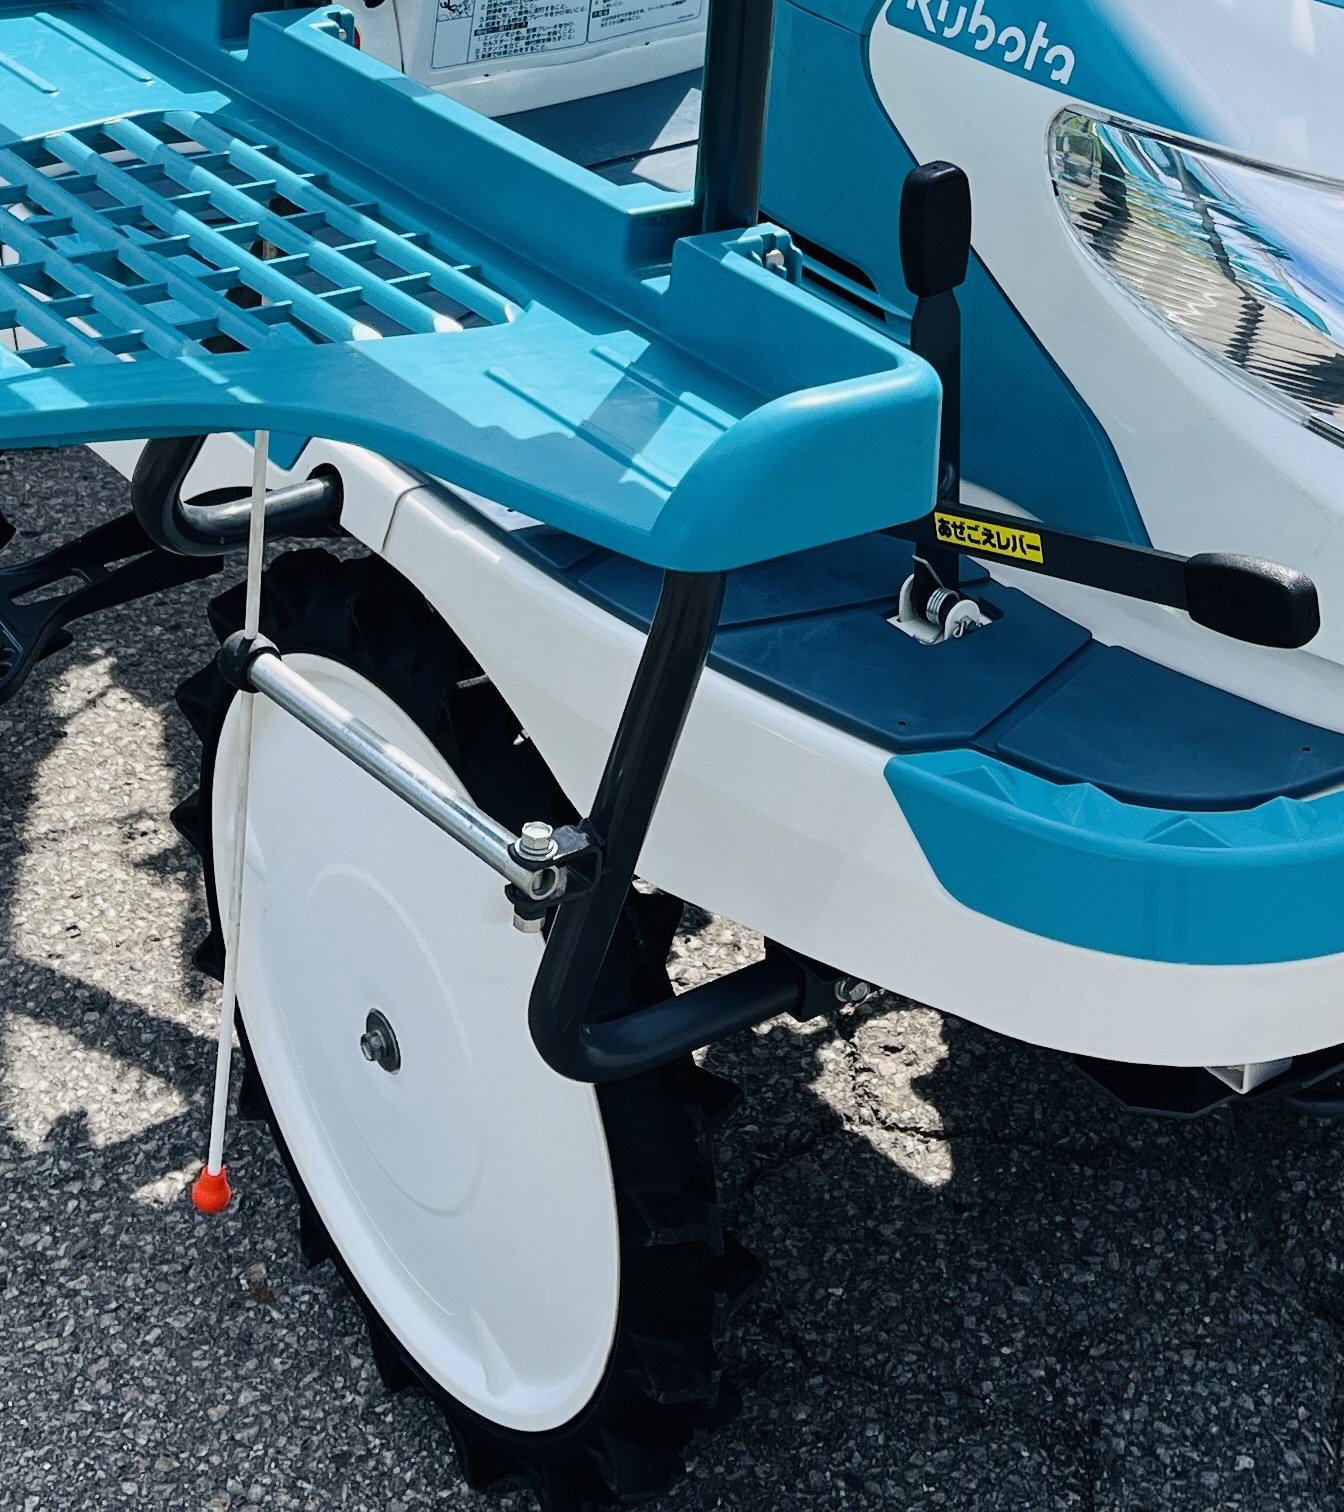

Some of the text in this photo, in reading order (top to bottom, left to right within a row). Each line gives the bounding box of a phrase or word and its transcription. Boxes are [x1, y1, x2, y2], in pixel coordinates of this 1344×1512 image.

[938, 518, 1040, 555] あぜごえレバー
